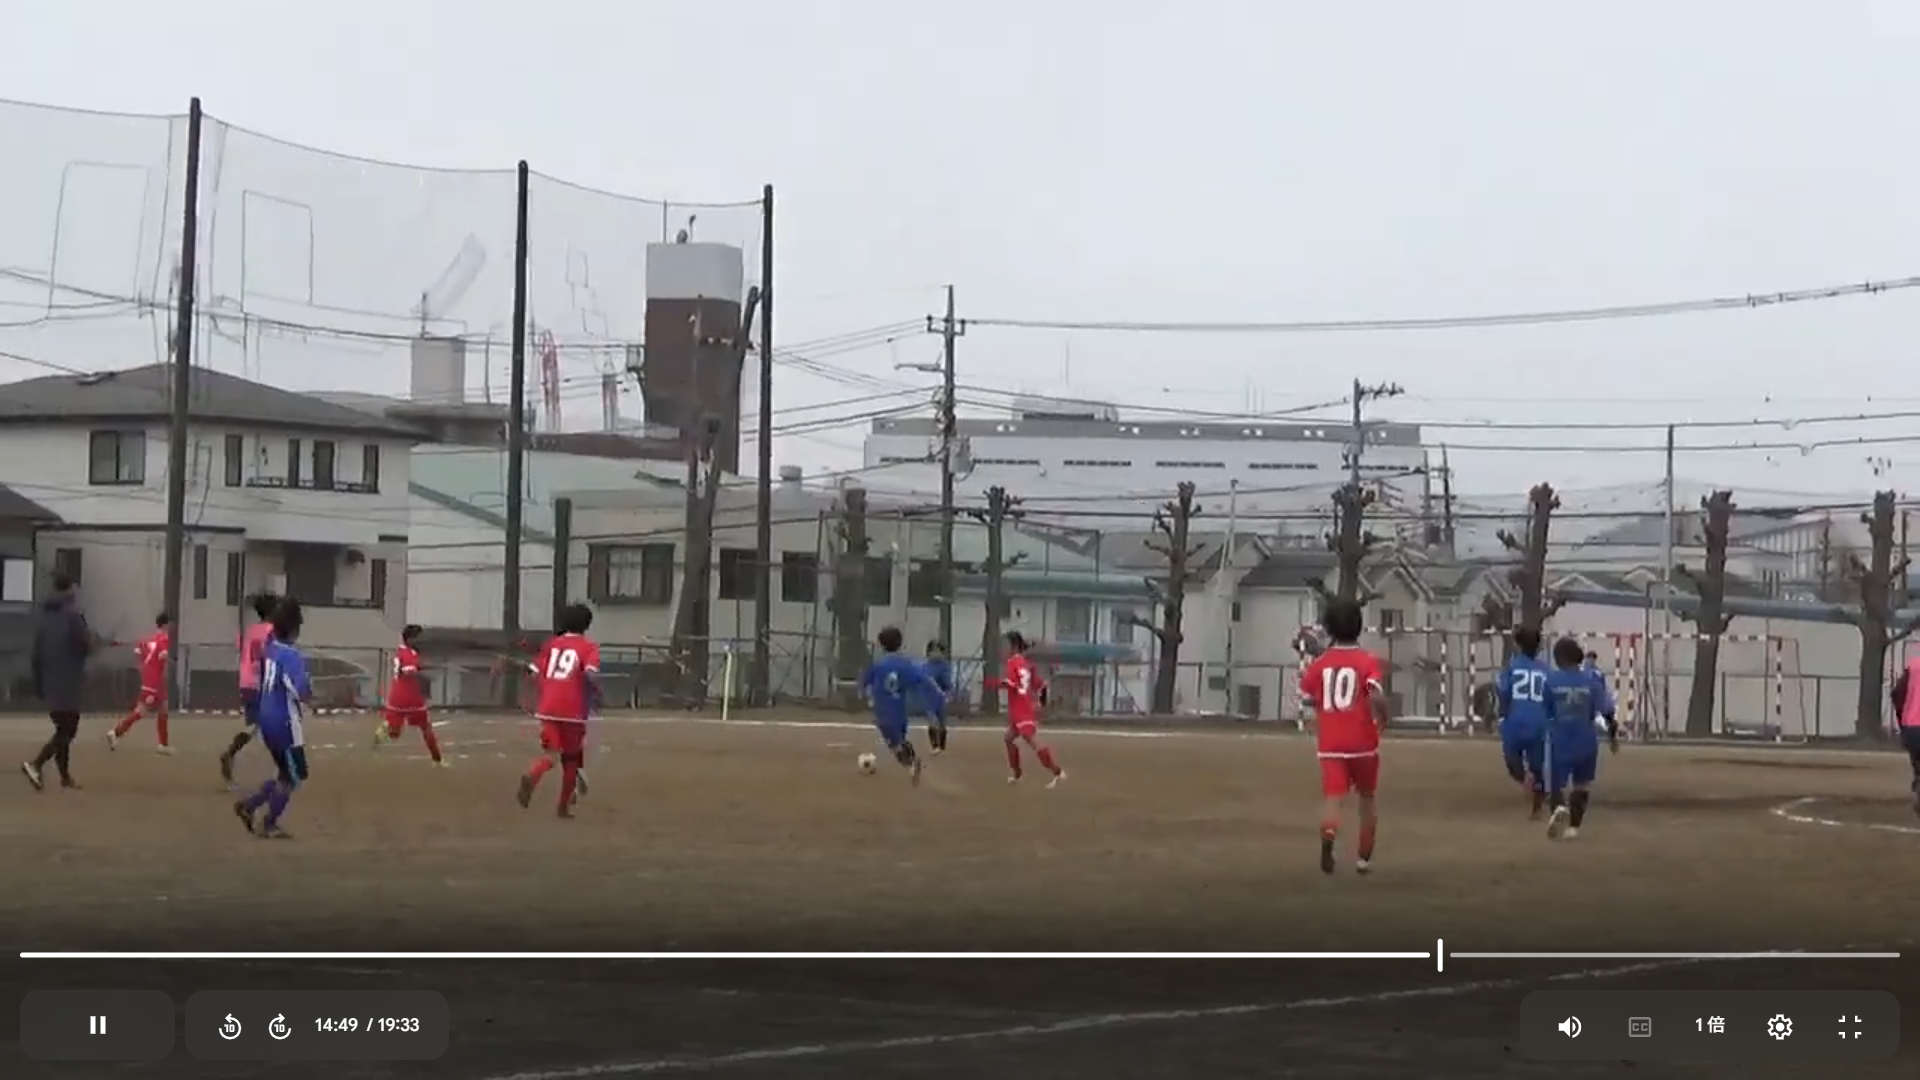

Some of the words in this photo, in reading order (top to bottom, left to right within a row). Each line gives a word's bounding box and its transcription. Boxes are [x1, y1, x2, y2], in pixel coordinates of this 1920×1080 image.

[542, 647, 577, 679] 19
[1016, 668, 1031, 695] 3
[1322, 666, 1356, 711] 10
[1512, 668, 1547, 702] 20
